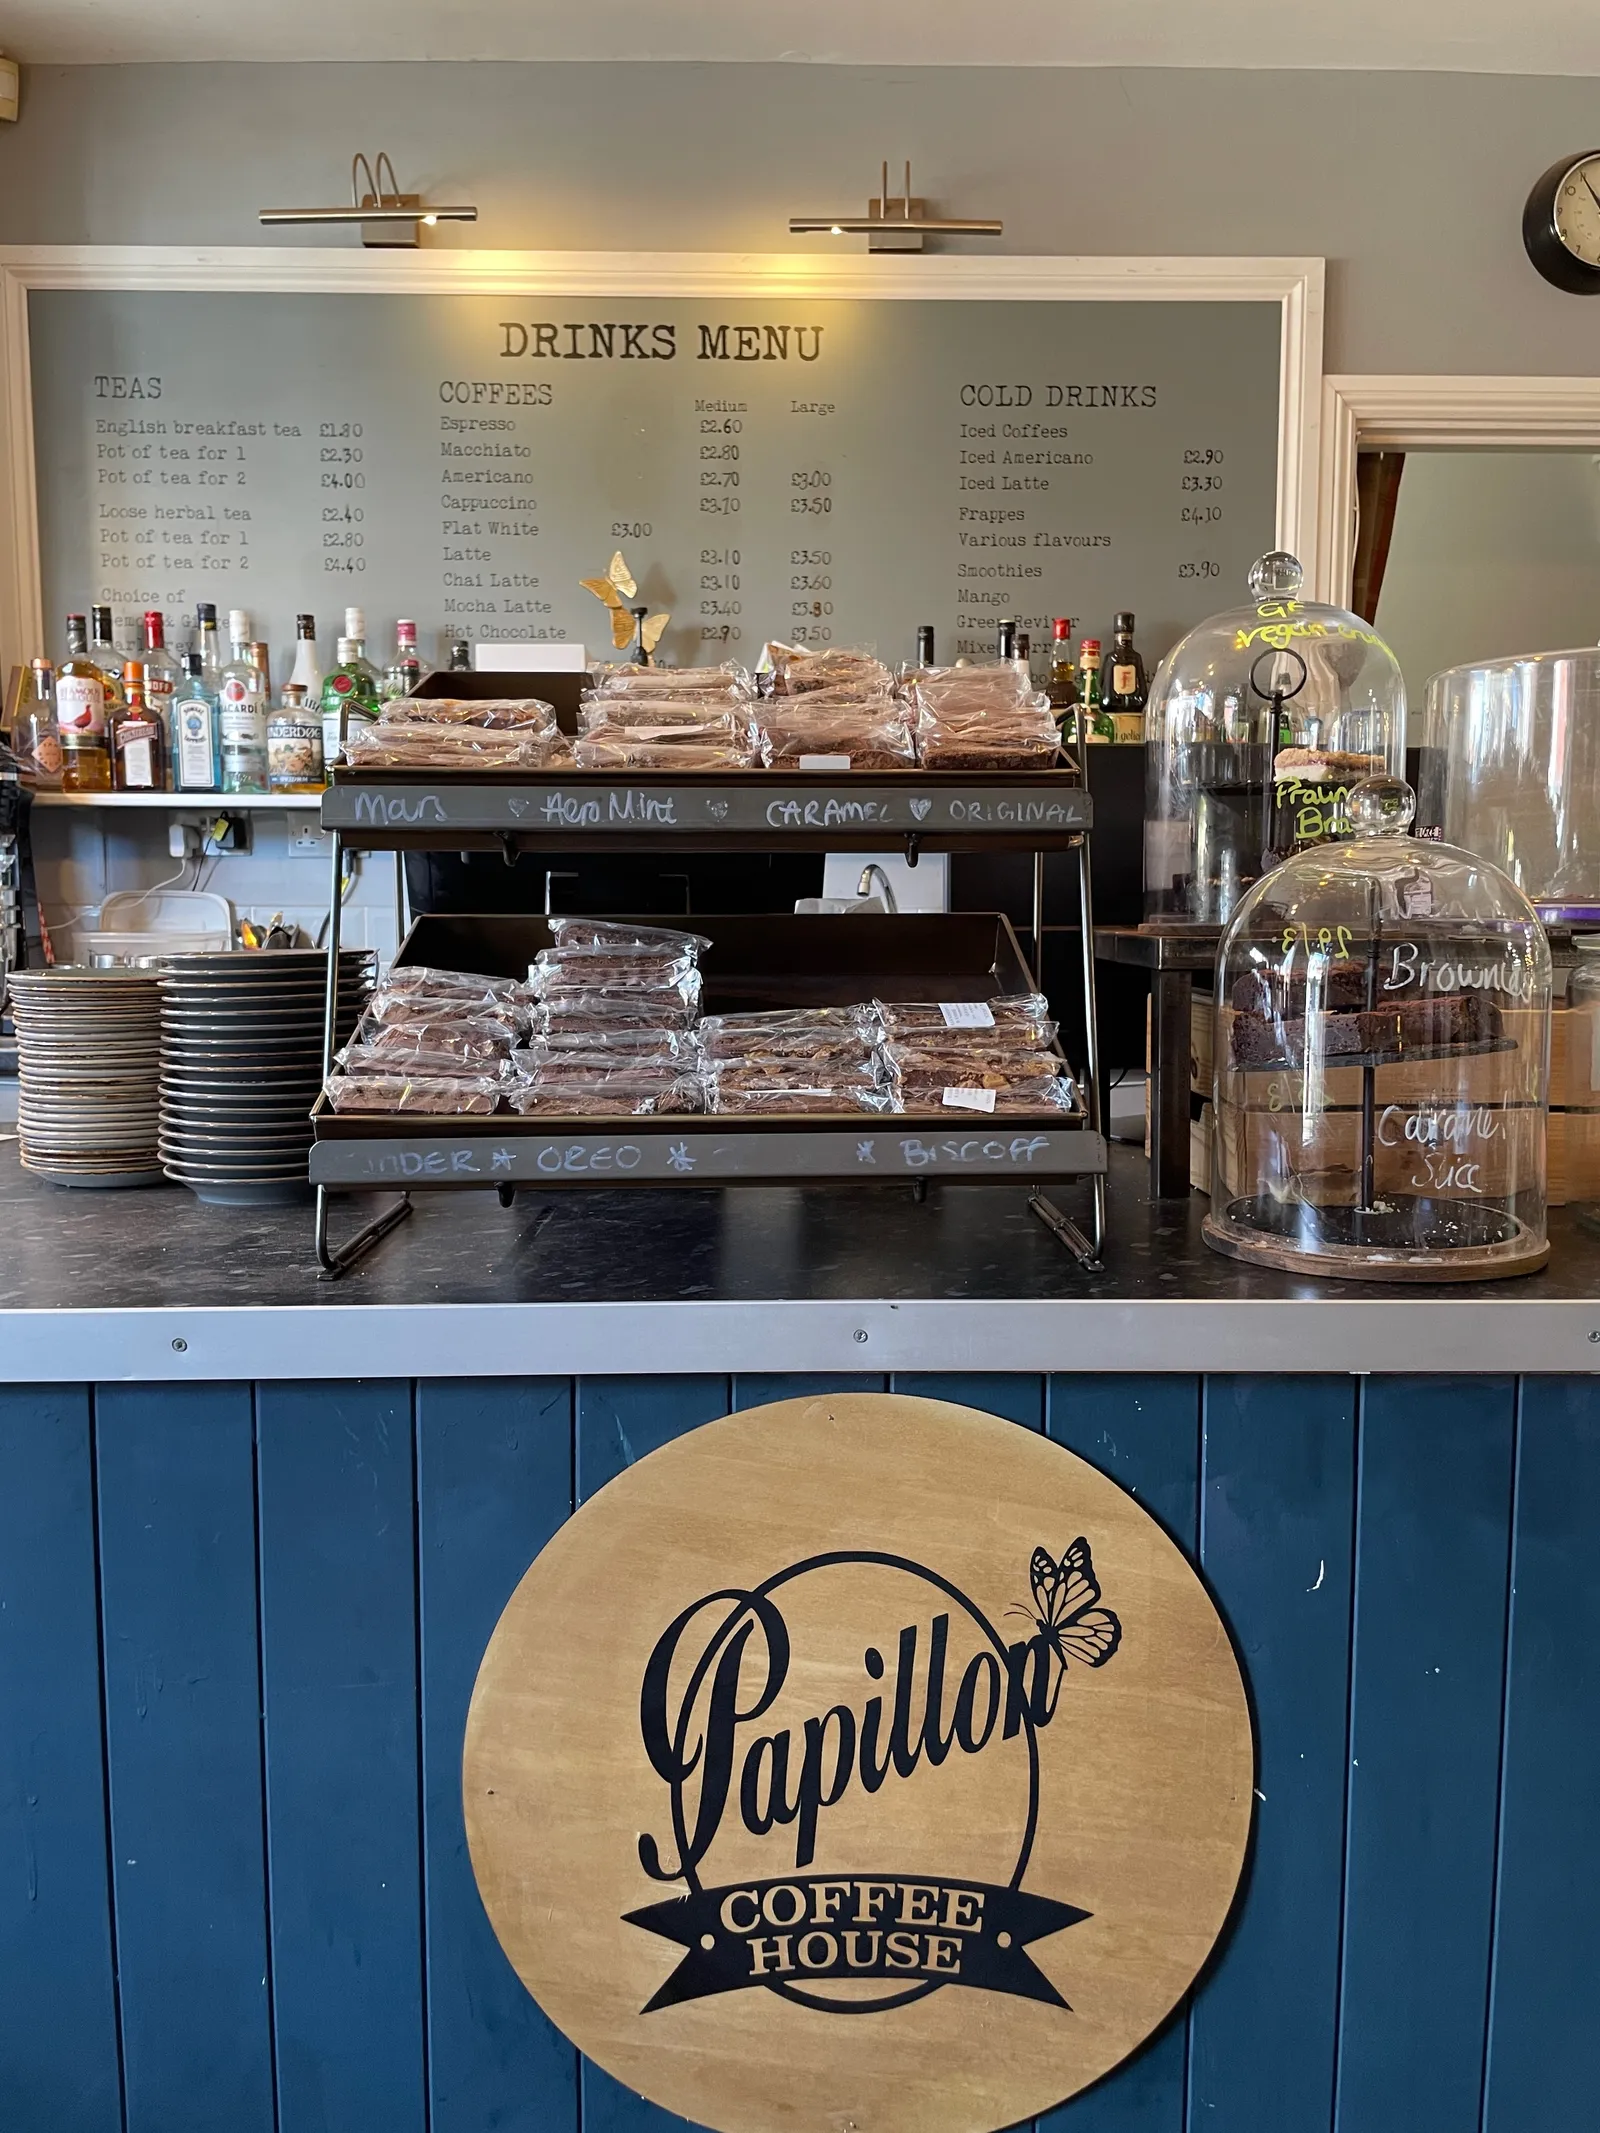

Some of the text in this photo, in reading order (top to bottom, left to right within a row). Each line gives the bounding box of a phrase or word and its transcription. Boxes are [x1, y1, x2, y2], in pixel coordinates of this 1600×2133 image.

[499, 323, 823, 361] DRINKS MENU
[95, 376, 161, 399] TEAS
[440, 381, 552, 405] COFFEES
[961, 385, 1156, 407] COLD DRINKS
[695, 400, 747, 412] Medium
[791, 401, 835, 415] Large
[96, 419, 362, 437] English breakfast tea £1.80
[440, 416, 742, 434] Espresso £2.60
[960, 424, 1068, 438] Iced Coffees
[98, 444, 128, 458] Pot
[132, 444, 152, 458] of
[160, 446, 190, 459] tea
[198, 446, 227, 460] for
[320, 448, 362, 463] £2.30
[441, 442, 739, 460] Macchiato £2.80
[960, 450, 1223, 465] Iced Americano £2.90
[98, 469, 127, 483] Pot
[133, 470, 152, 484] of
[160, 472, 191, 484] tea
[199, 471, 228, 485] for
[321, 473, 365, 489] £4.00
[442, 470, 831, 490] Americano £2.70 £3.00
[960, 476, 1222, 492] Iced Latte £3.30
[100, 504, 363, 523] Loose herbal tea £2.40
[442, 495, 831, 515] Cappuccino £3.10 £3.50
[959, 507, 1221, 525] Frappes £4.10
[101, 529, 129, 543] Pot
[135, 529, 155, 543] of
[162, 531, 193, 544] tea
[201, 530, 230, 544] for
[323, 533, 363, 547] £2.80
[442, 521, 652, 538] Flat White £3.00
[959, 533, 1111, 547] Various flavours
[101, 554, 129, 568] Pot
[136, 554, 155, 568] of
[164, 556, 194, 569] tea
[201, 555, 230, 569] for
[325, 558, 365, 573] £4.40
[443, 547, 831, 565] Latte £3.10 £3.50
[958, 561, 1219, 578] Smoothies £3.90
[444, 573, 831, 591] Chai Latte £3.10 £3.60
[103, 588, 185, 603] Choice of
[958, 589, 1009, 606] Mango
[445, 599, 833, 617] Mocha Latte £3.40 £3.80
[1014, 615, 1080, 629] Revir
[444, 625, 831, 644] Hot Chocolate £2.90 £3.50
[166, 641, 194, 654] rey
[957, 640, 998, 654] Mixe
[353, 791, 447, 825] Mars
[766, 799, 893, 827] CARAMEL
[949, 800, 1083, 823] ORIGINAL
[537, 1145, 642, 1172] OREO
[638, 1589, 1066, 1881] Papillon
[719, 1881, 985, 1934] COFFEE
[746, 1931, 963, 1975] HOUSE
